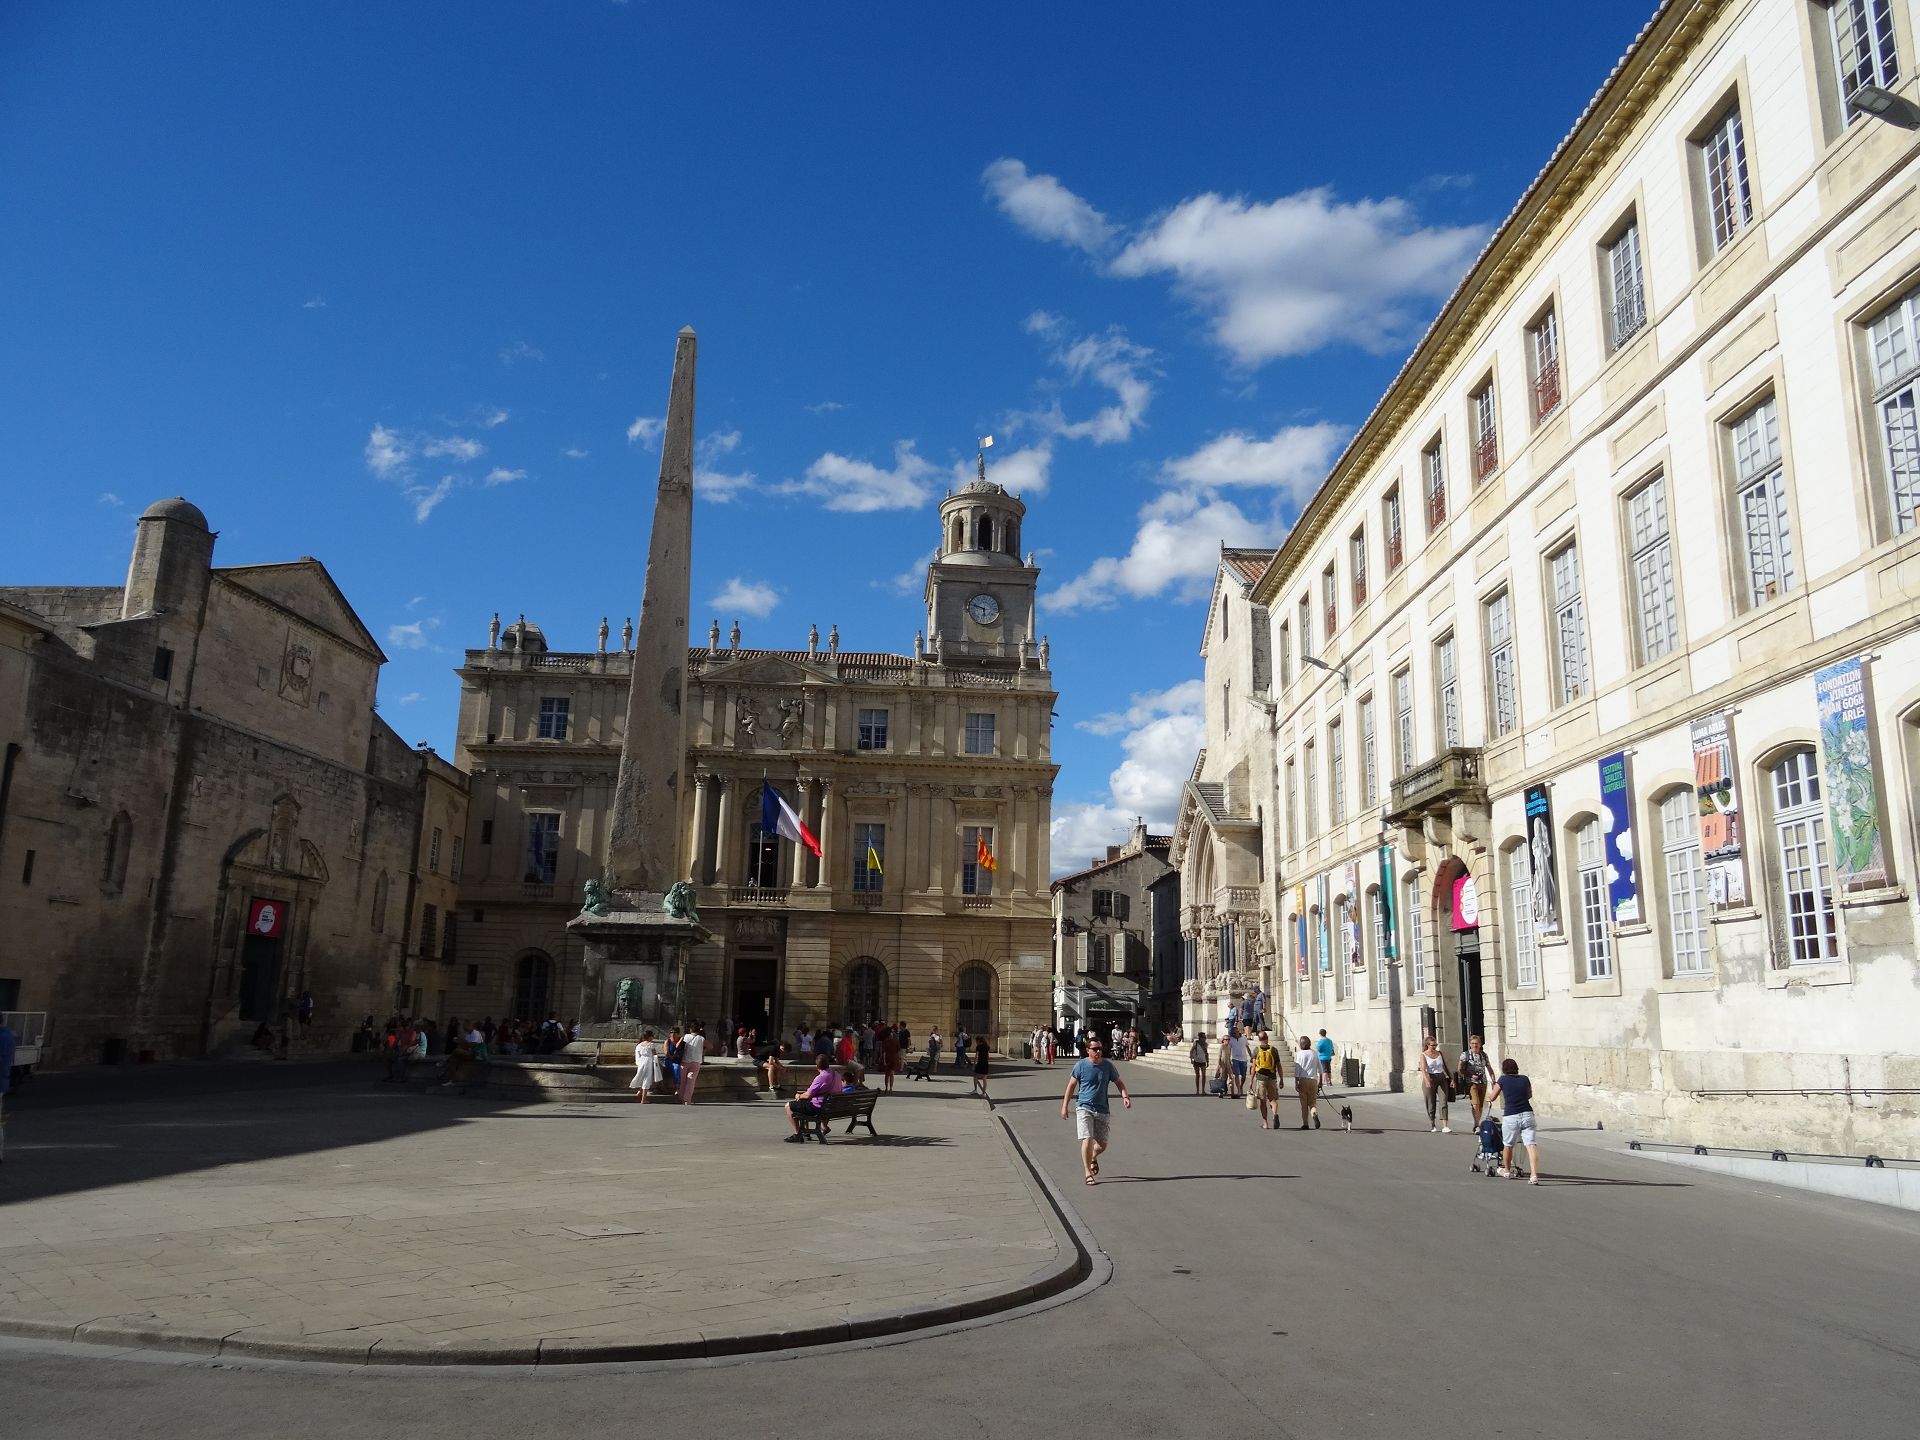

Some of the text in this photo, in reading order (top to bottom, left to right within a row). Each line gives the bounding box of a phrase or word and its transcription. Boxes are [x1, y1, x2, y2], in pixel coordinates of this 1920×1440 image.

[1818, 669, 1861, 692] FONDATION
[1830, 681, 1862, 701] VINCENT
[1842, 693, 1865, 709] GOGH
[1842, 705, 1866, 722] ARLES
[1709, 720, 1727, 735] ARLES
